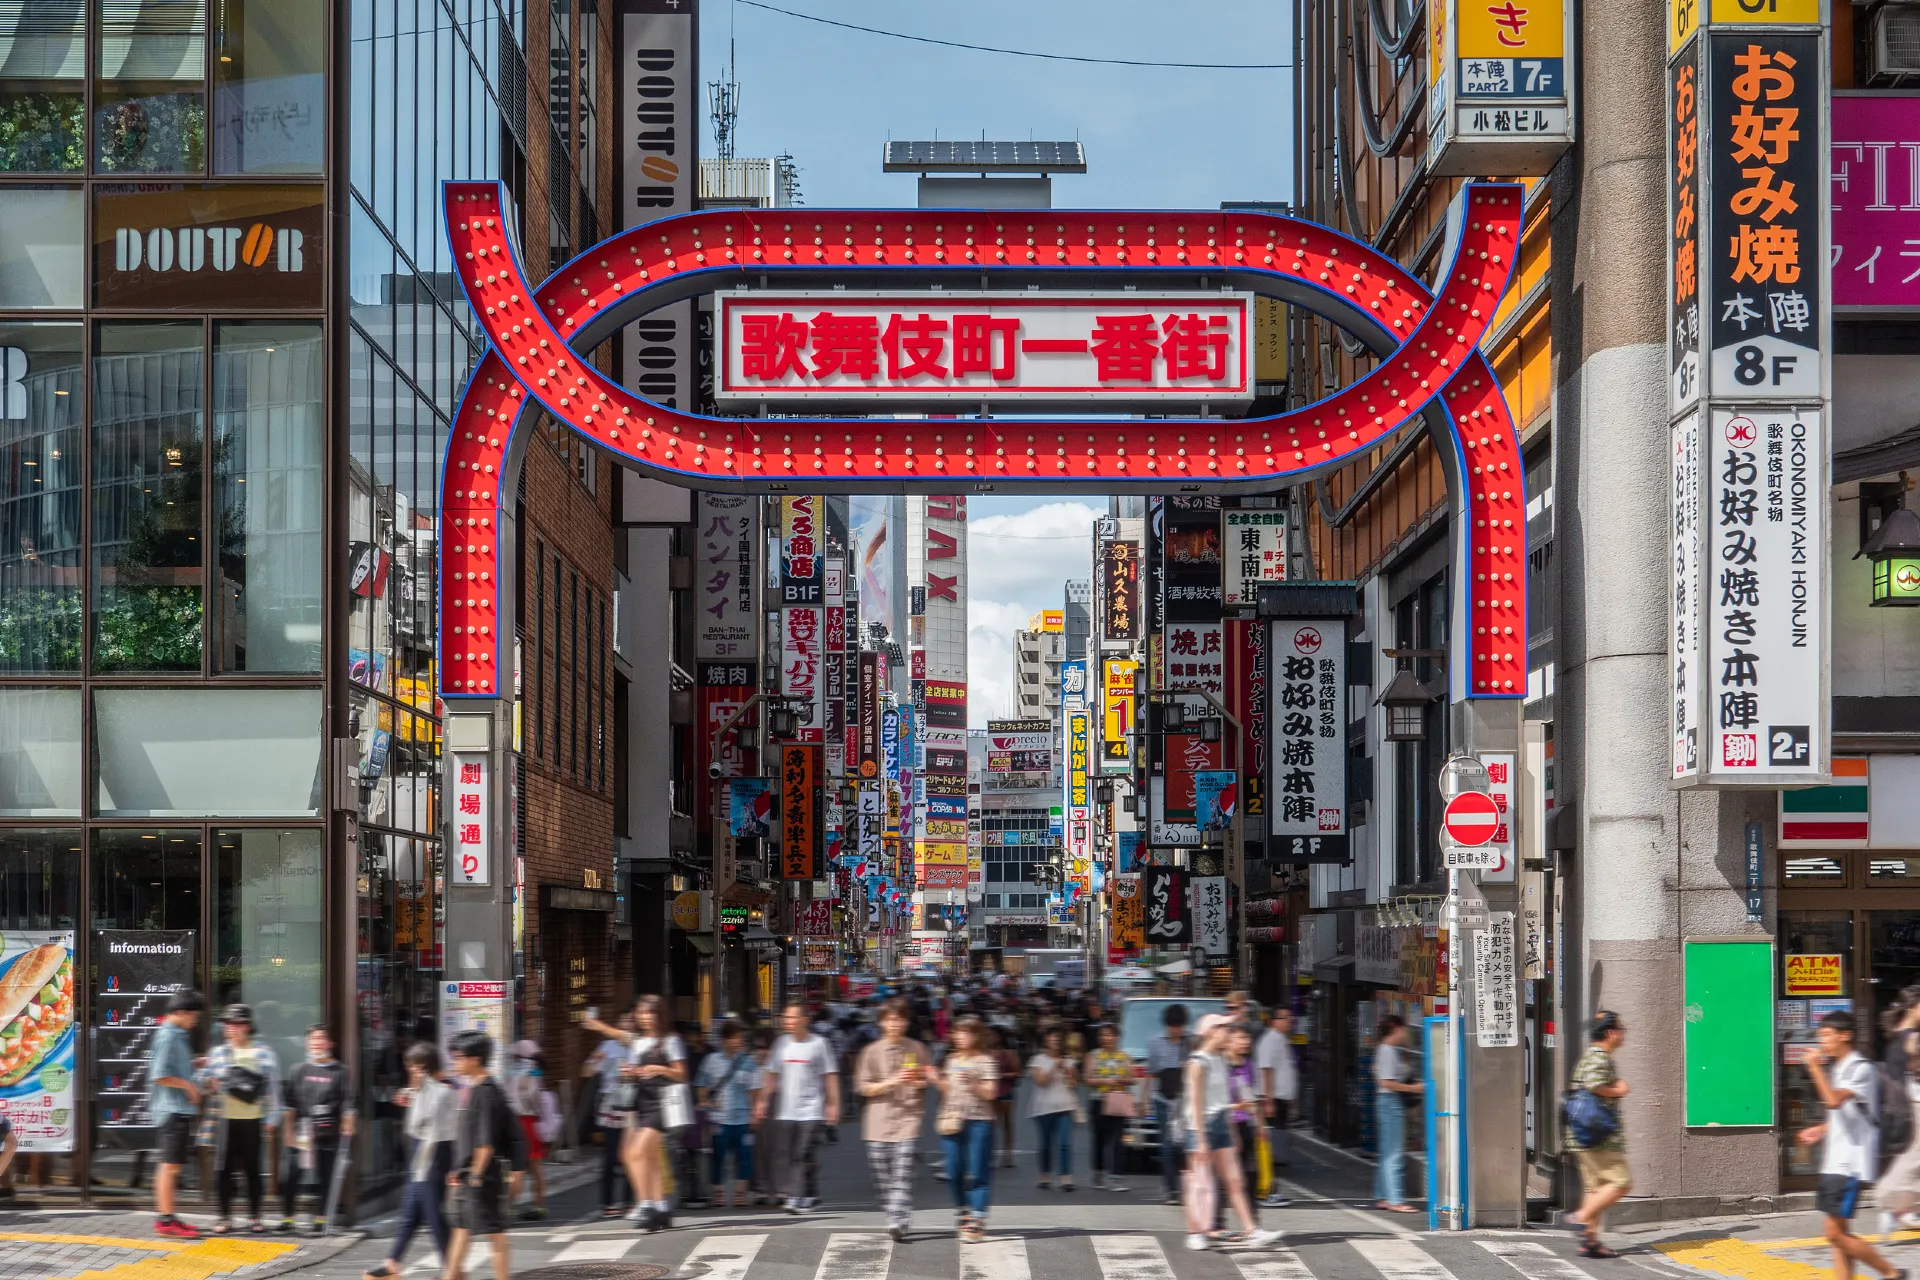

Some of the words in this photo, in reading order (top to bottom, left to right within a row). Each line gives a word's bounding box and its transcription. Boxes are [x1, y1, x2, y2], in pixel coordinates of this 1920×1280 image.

[1488, 1, 1528, 46] き
[1468, 60, 1505, 79] 本陣
[1521, 61, 1552, 92] 7F
[637, 49, 680, 207] DOUTOR
[1473, 110, 1549, 132] 小松ビル
[1731, 45, 1801, 284] お好み焼
[1675, 65, 1697, 305] お好み焼
[116, 223, 303, 272] DOUTOR
[1722, 289, 1810, 333] 本陣
[741, 312, 1230, 383] 歌舞伎町一番街
[1734, 345, 1798, 387] 8F
[1680, 361, 1695, 399] 8F
[1767, 423, 1783, 522] 歌舞伎町名物
[1790, 423, 1807, 565] OKONOMIYAKI
[1228, 513, 1285, 525] 全卓全自動
[703, 516, 734, 620] バンタイ
[739, 517, 750, 612] タイ国料理専門店
[1240, 528, 1260, 603] 東南荘
[1263, 551, 1274, 579] 専門
[786, 585, 819, 600] B1F
[1112, 561, 1130, 630] 山久農場
[1720, 449, 1760, 730] お好み焼き本陣
[1790, 570, 1807, 648] HONJIN
[703, 633, 751, 641] RESTAURANT
[715, 643, 738, 656] 3F
[707, 666, 747, 684] 焼肉
[925, 685, 965, 699] 全店営業中
[863, 664, 873, 754] 個室ダイニング居酒屋
[883, 713, 898, 769] カラオケ
[1281, 655, 1317, 824] お好み焼本陣
[1771, 732, 1808, 760] 2F
[1072, 717, 1086, 806] まんが喫茶
[459, 763, 481, 875] 劇場通り
[889, 790, 898, 818] 麻雀
[900, 768, 912, 836] カラオケ
[925, 849, 951, 861] ゲーム
[1291, 836, 1323, 855] 2F
[1448, 853, 1496, 865] 自転車を除く
[1749, 898, 1761, 909] 17
[110, 942, 182, 954] information
[1476, 935, 1484, 961] Security
[1483, 953, 1491, 975] Safety
[1787, 956, 1840, 968] ATM
[143, 983, 158, 993] 4F
[1490, 923, 1504, 1024] 防犯カメラ作動中
[1501, 917, 1514, 1030] みなさまの安全を守ります
[43, 1095, 52, 1107] B
[12, 1125, 69, 1139] サーモン
